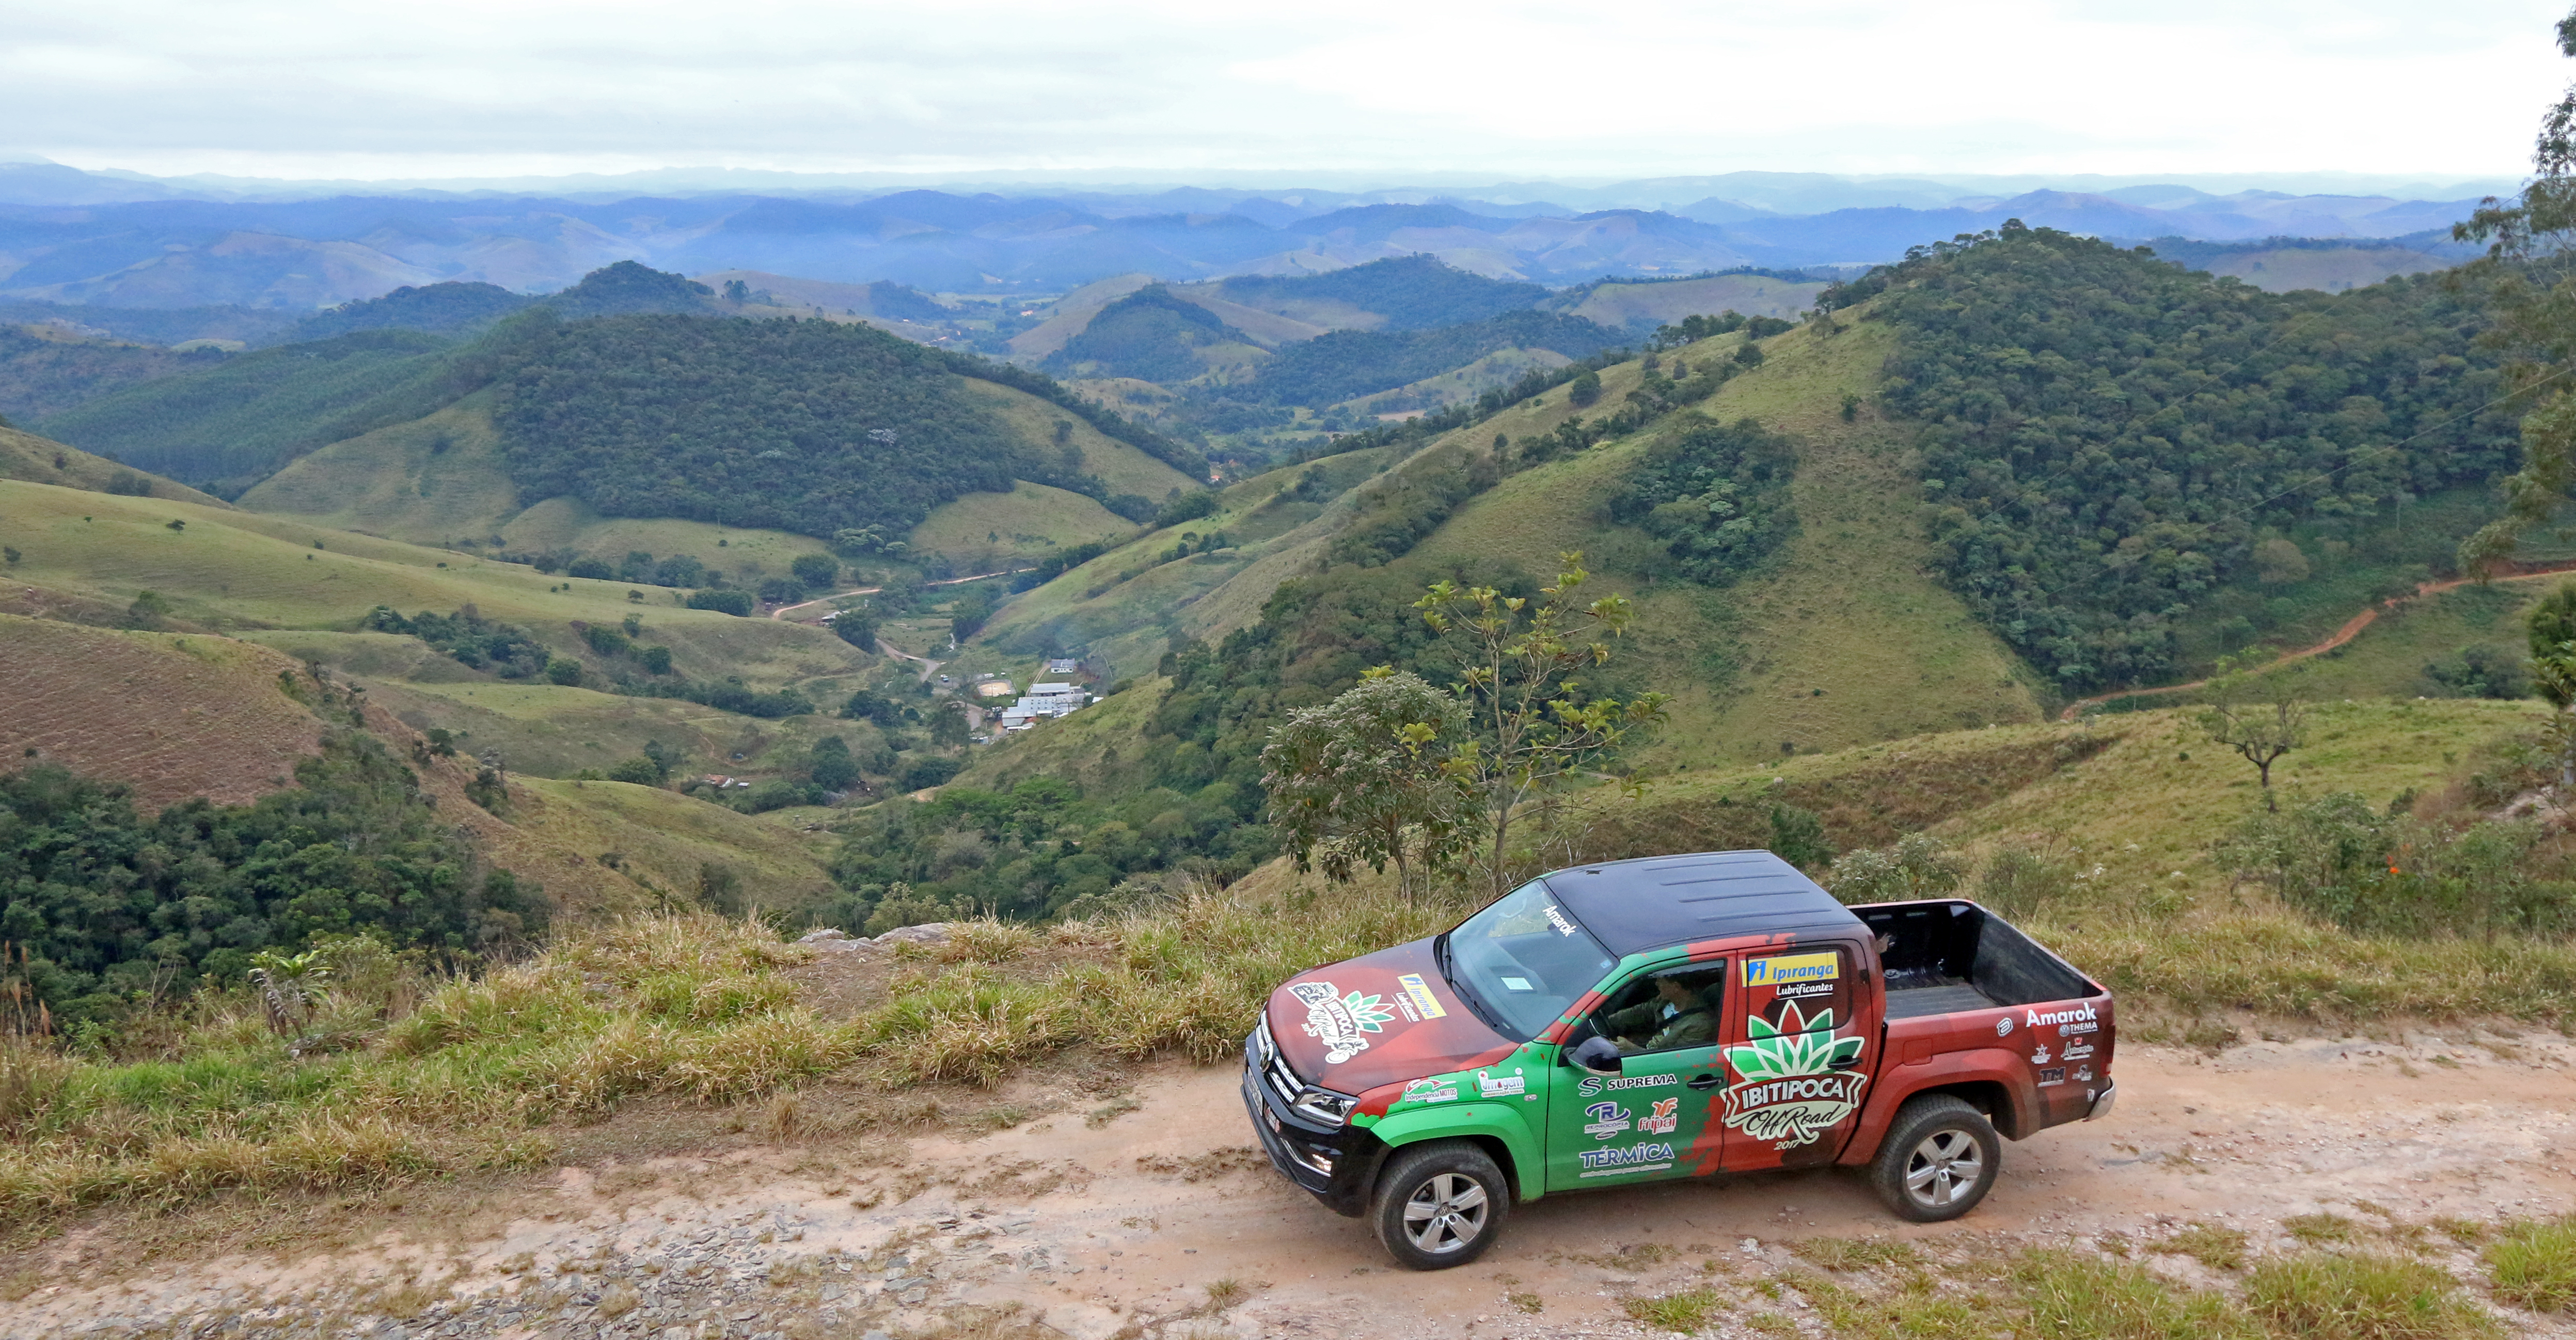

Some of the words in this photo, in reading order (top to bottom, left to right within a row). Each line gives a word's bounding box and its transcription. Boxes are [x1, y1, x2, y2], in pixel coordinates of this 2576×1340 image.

[1542, 905, 1576, 937] Amarok
[1773, 963, 1834, 981] Ipiranga
[1404, 988, 1435, 1016] Ipiranga
[1776, 983, 1834, 997] Lubrificantes
[1325, 1001, 1354, 1036] IBITIPOCA
[1396, 992, 1420, 1022] Lubrificantes
[2026, 1002, 2097, 1028] Amarok
[2070, 1021, 2097, 1032] THEMA
[1608, 1074, 1677, 1090] SUPREMA
[1742, 1078, 1844, 1109] IBITIPOCA
[1781, 1104, 1849, 1141] Road
[1774, 1139, 1800, 1150] 2017
